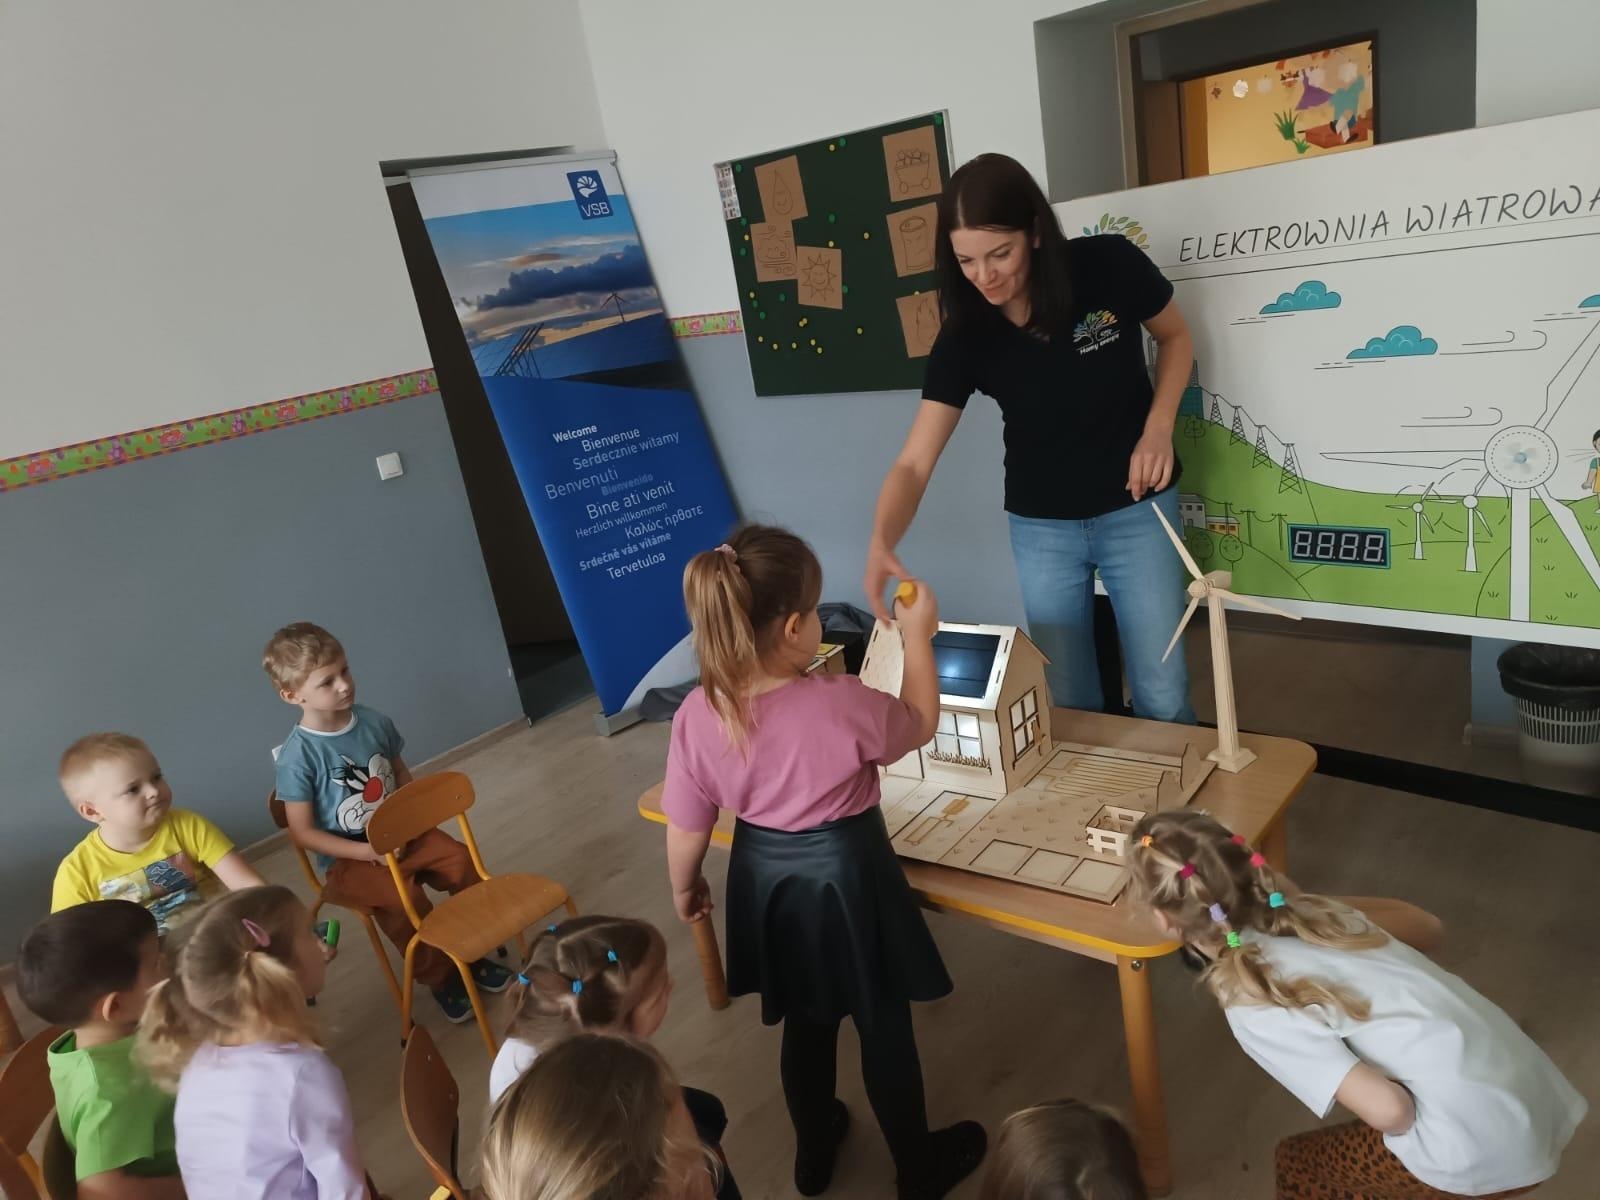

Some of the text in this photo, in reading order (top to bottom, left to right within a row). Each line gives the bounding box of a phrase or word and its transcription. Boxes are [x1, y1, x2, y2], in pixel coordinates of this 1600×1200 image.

[581, 202, 610, 217] VSB
[1179, 209, 1390, 263] ELEKTROWNIA
[552, 425, 598, 443] Welcome
[581, 428, 641, 453] Bienvenue
[573, 431, 680, 470] Serdecznie witamy
[545, 465, 619, 500] Benvenuti
[586, 480, 676, 520] Bine ati venit
[575, 502, 668, 539] Herzlich willkommen
[579, 548, 621, 572] Srdečně
[621, 543, 640, 556] vás
[606, 552, 667, 580] Tervetuloa
